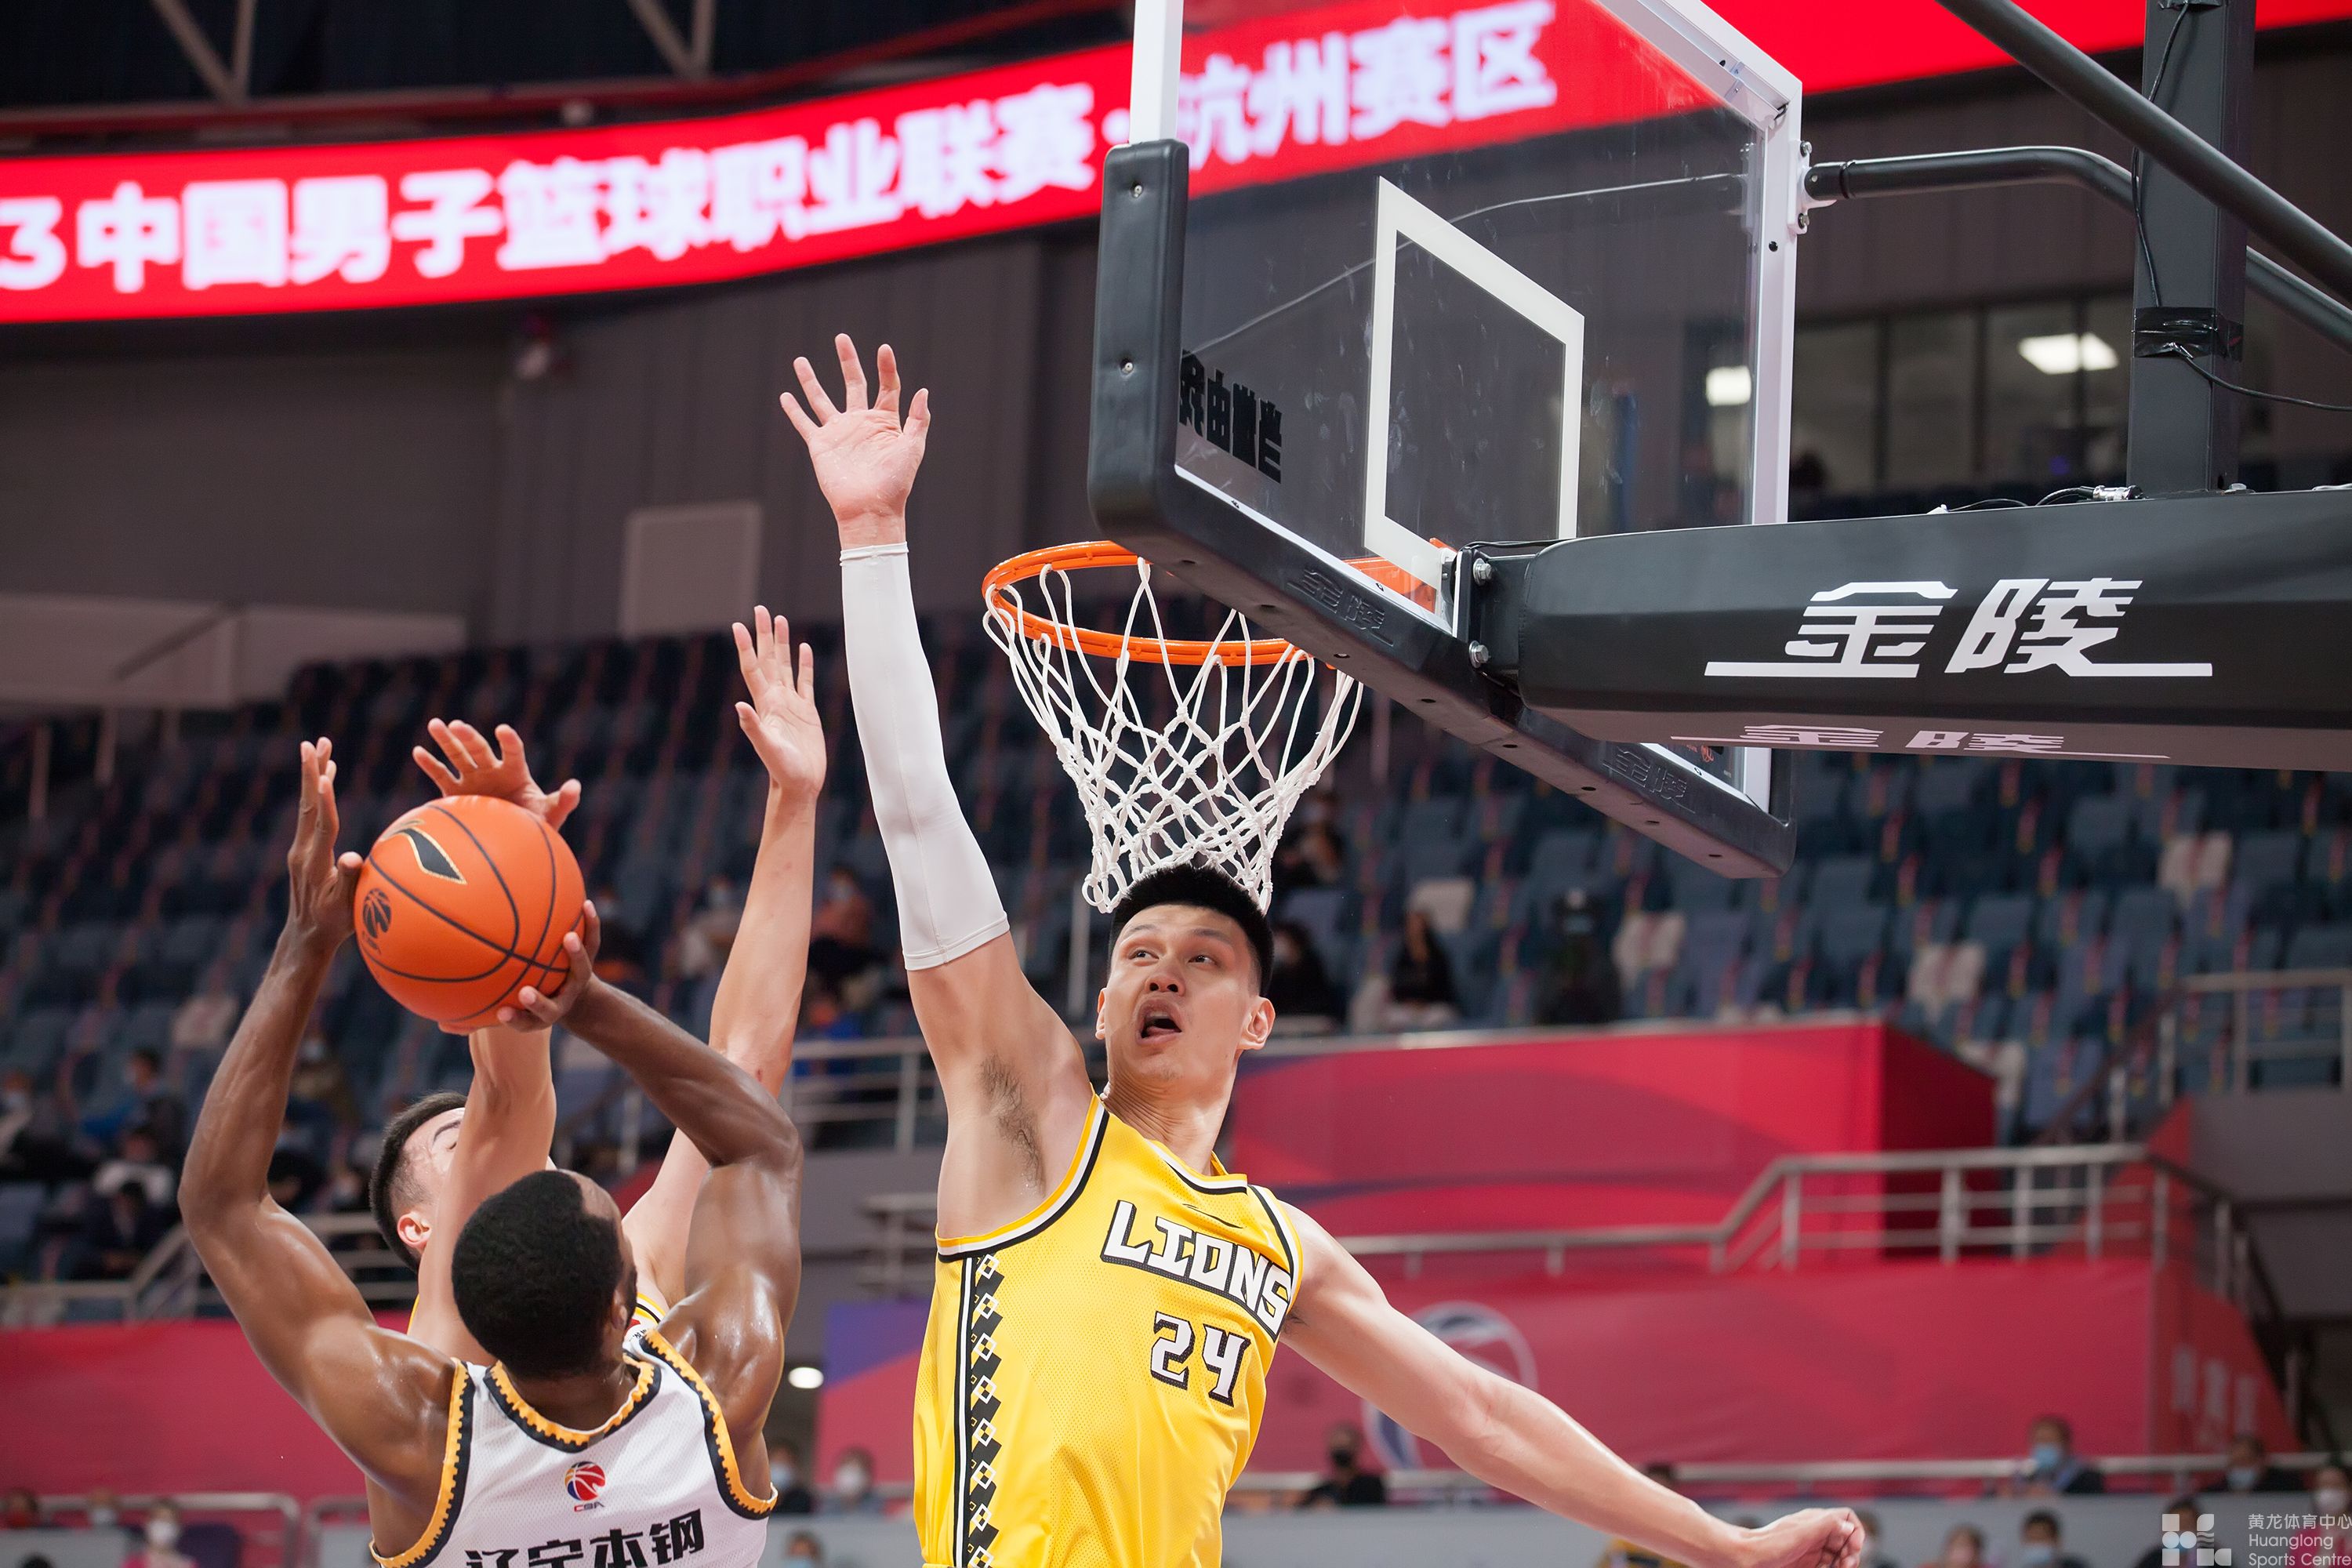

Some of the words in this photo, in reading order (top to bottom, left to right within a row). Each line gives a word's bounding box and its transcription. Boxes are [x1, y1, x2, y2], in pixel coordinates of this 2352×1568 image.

[1704, 577, 2212, 678] 金陵
[1670, 724, 2171, 759] 金陵
[1099, 1199, 1294, 1343] LIONS
[1150, 1310, 1252, 1408] 24
